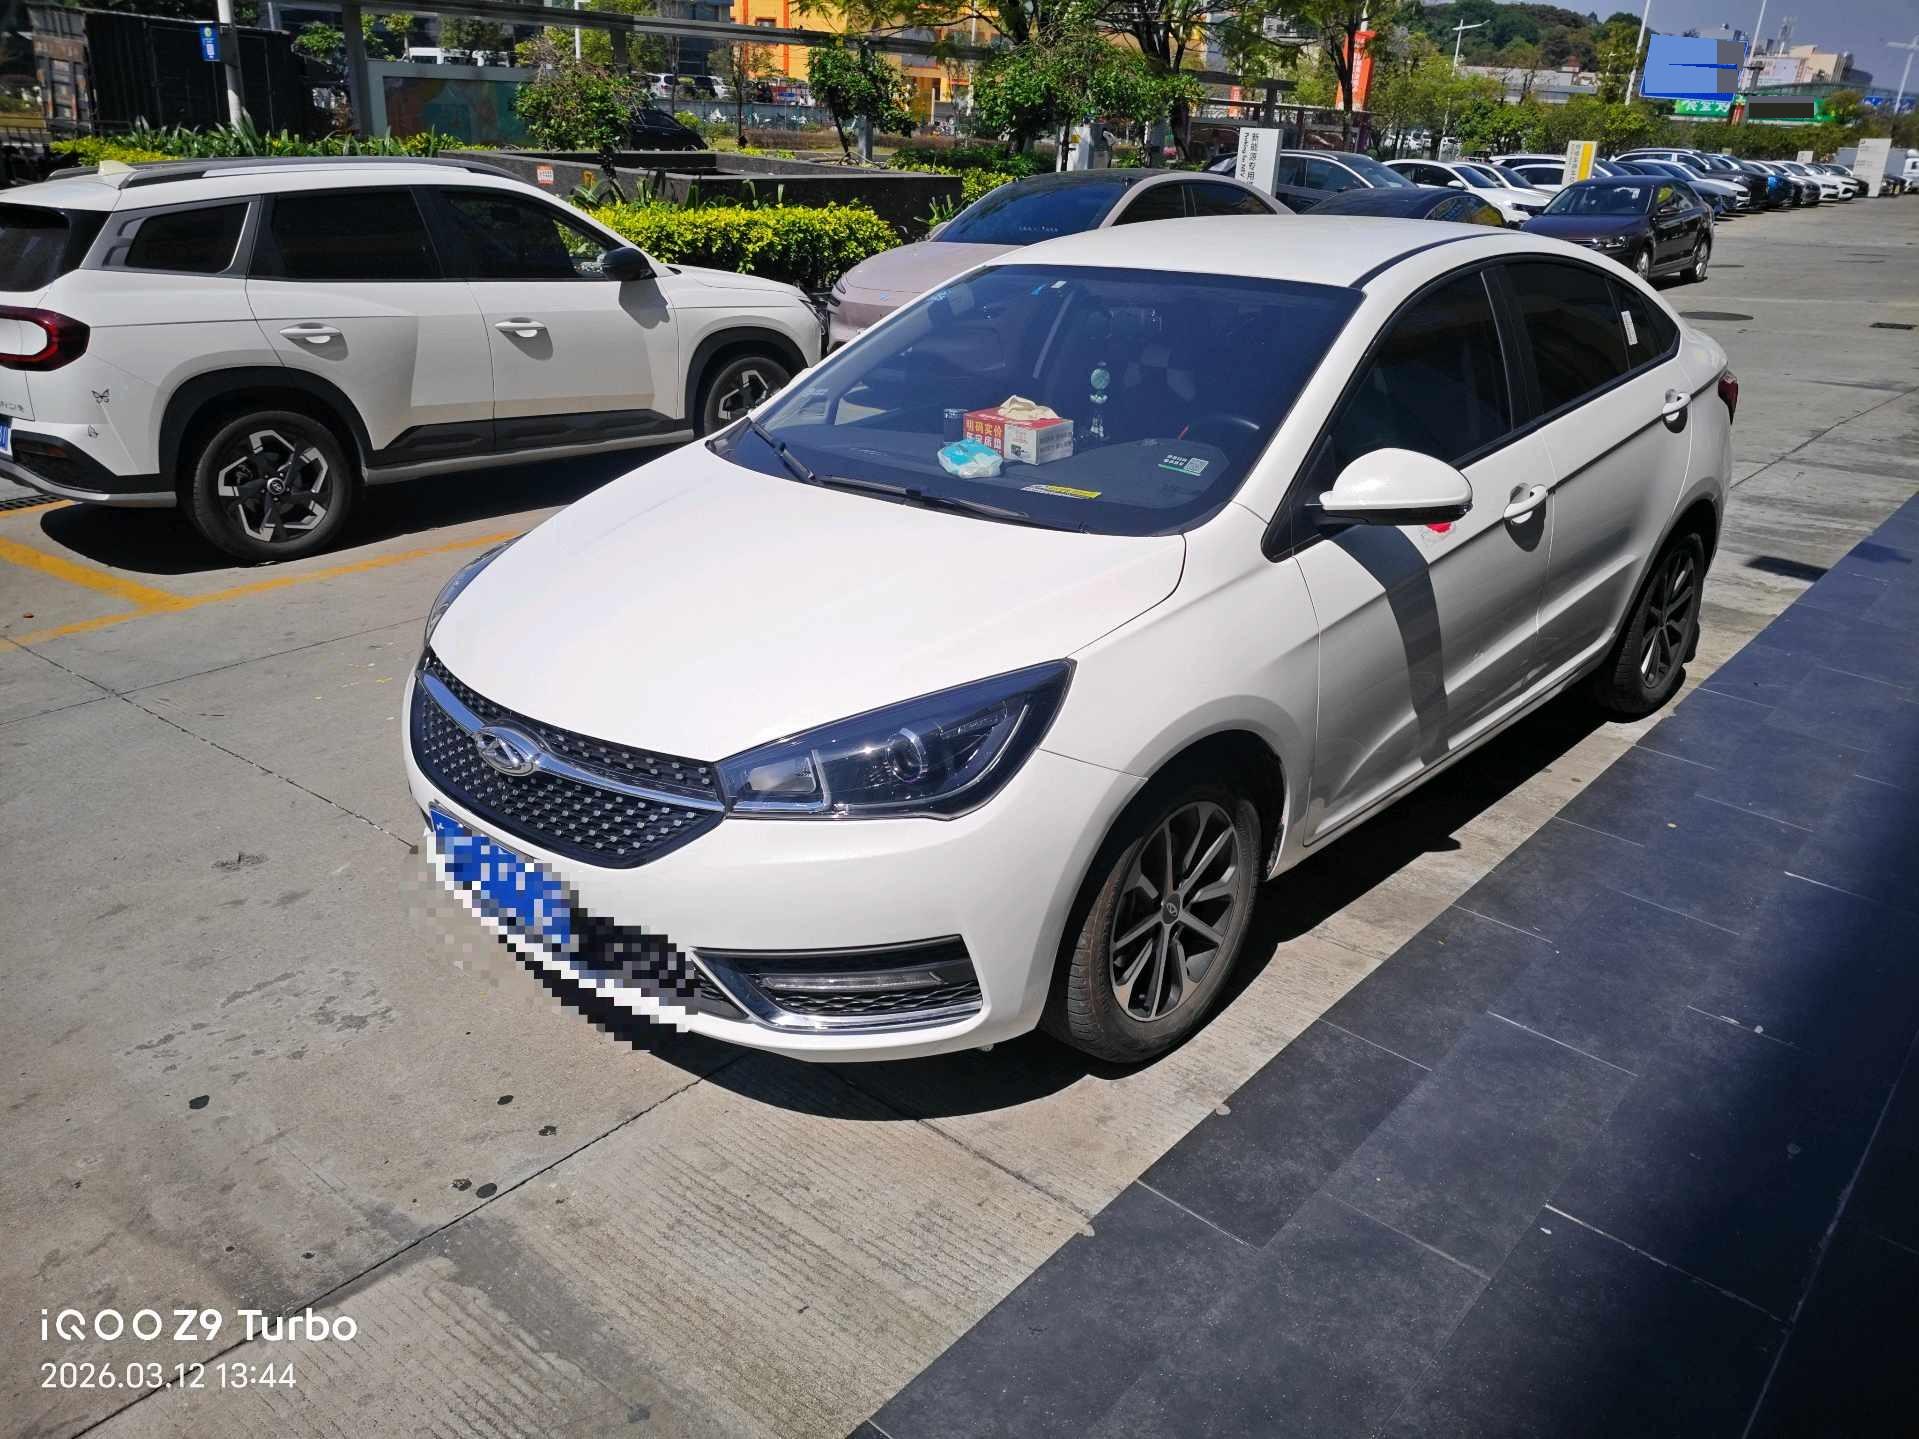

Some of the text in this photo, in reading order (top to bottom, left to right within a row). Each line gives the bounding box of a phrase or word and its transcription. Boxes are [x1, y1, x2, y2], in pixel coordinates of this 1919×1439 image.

[1247, 132, 1259, 185] 新能源专用
